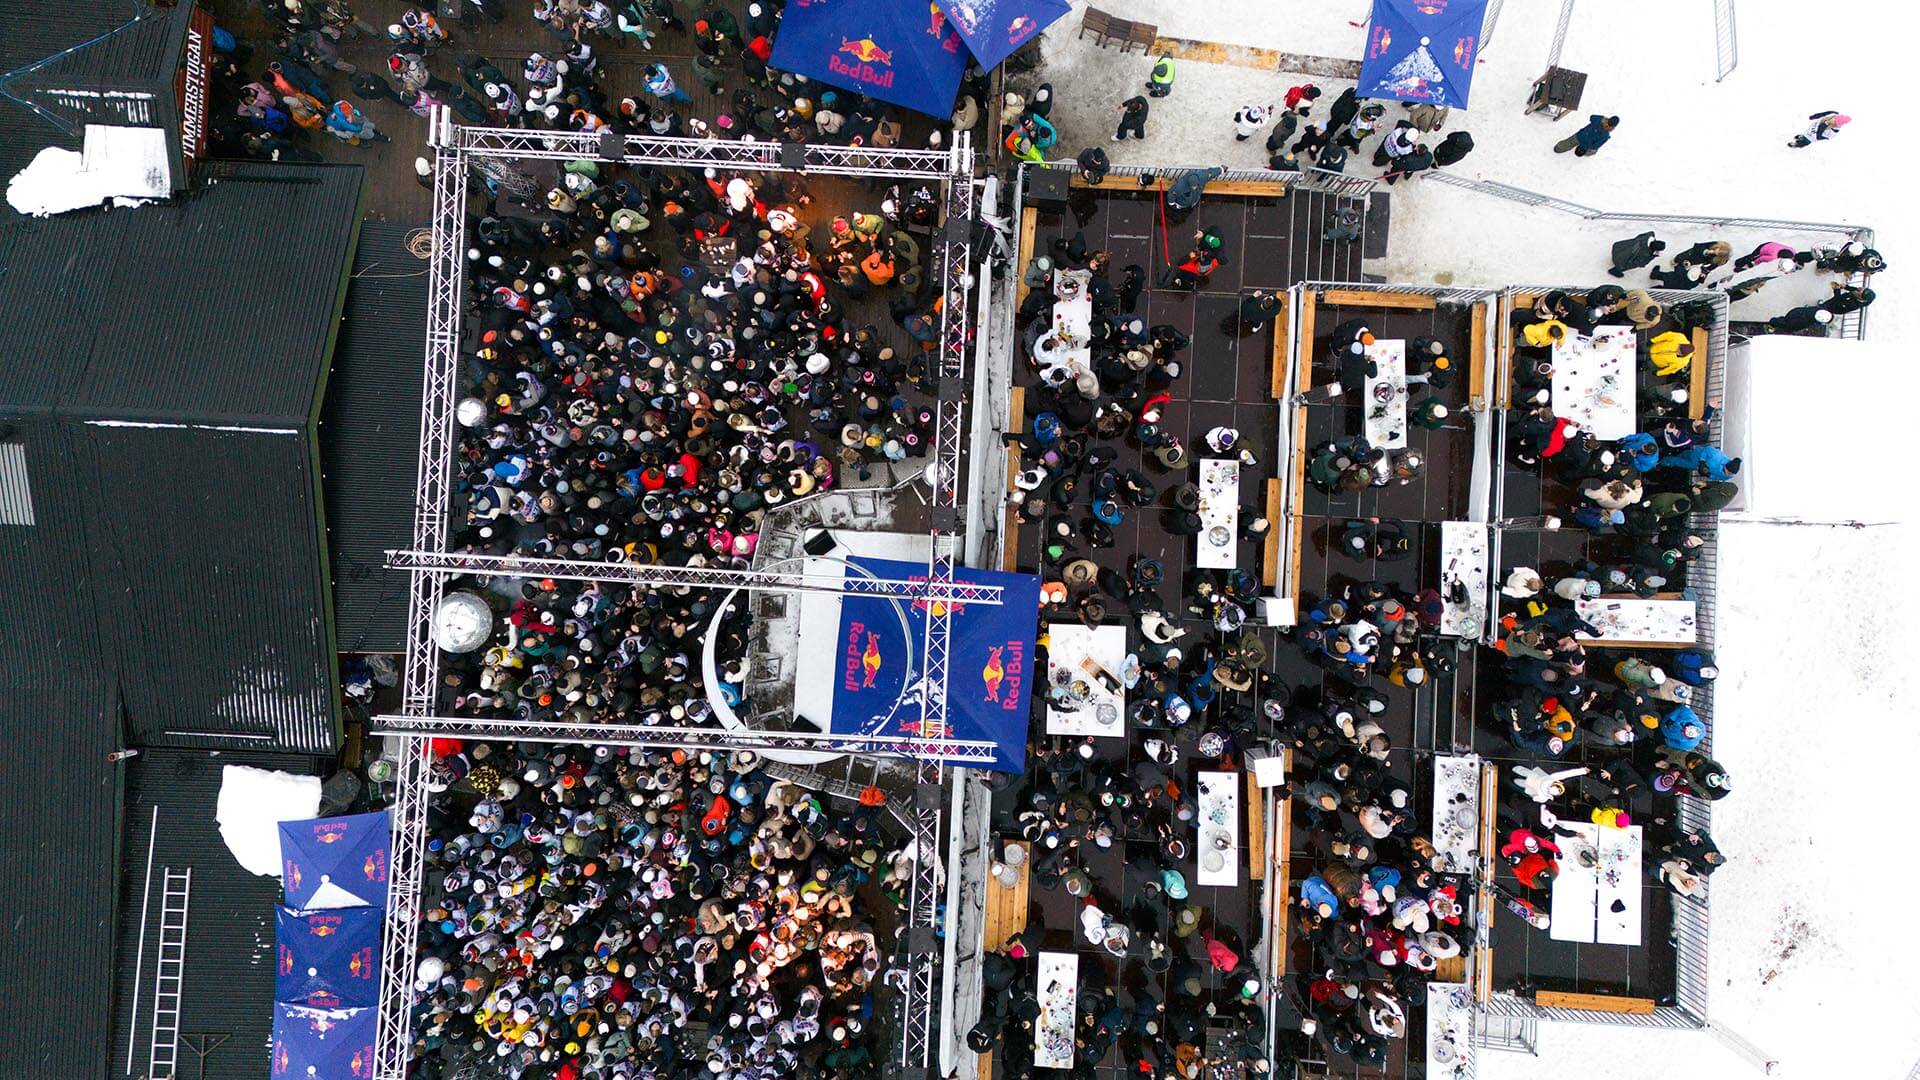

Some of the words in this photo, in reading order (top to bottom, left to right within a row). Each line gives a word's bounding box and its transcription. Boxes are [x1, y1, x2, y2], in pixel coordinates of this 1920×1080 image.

[829, 54, 862, 79] Red
[862, 65, 894, 88] Bull
[183, 28, 202, 159] TIMMERSTUGAN
[197, 88, 205, 138] RESTAURANG
[848, 621, 865, 657] Red
[845, 657, 860, 691] Bull
[1007, 641, 1023, 674] Bull
[1003, 675, 1020, 710] Red
[313, 824, 330, 833] Bull
[331, 822, 348, 831] Red
[375, 848, 385, 864] Bull
[377, 864, 386, 881] Red
